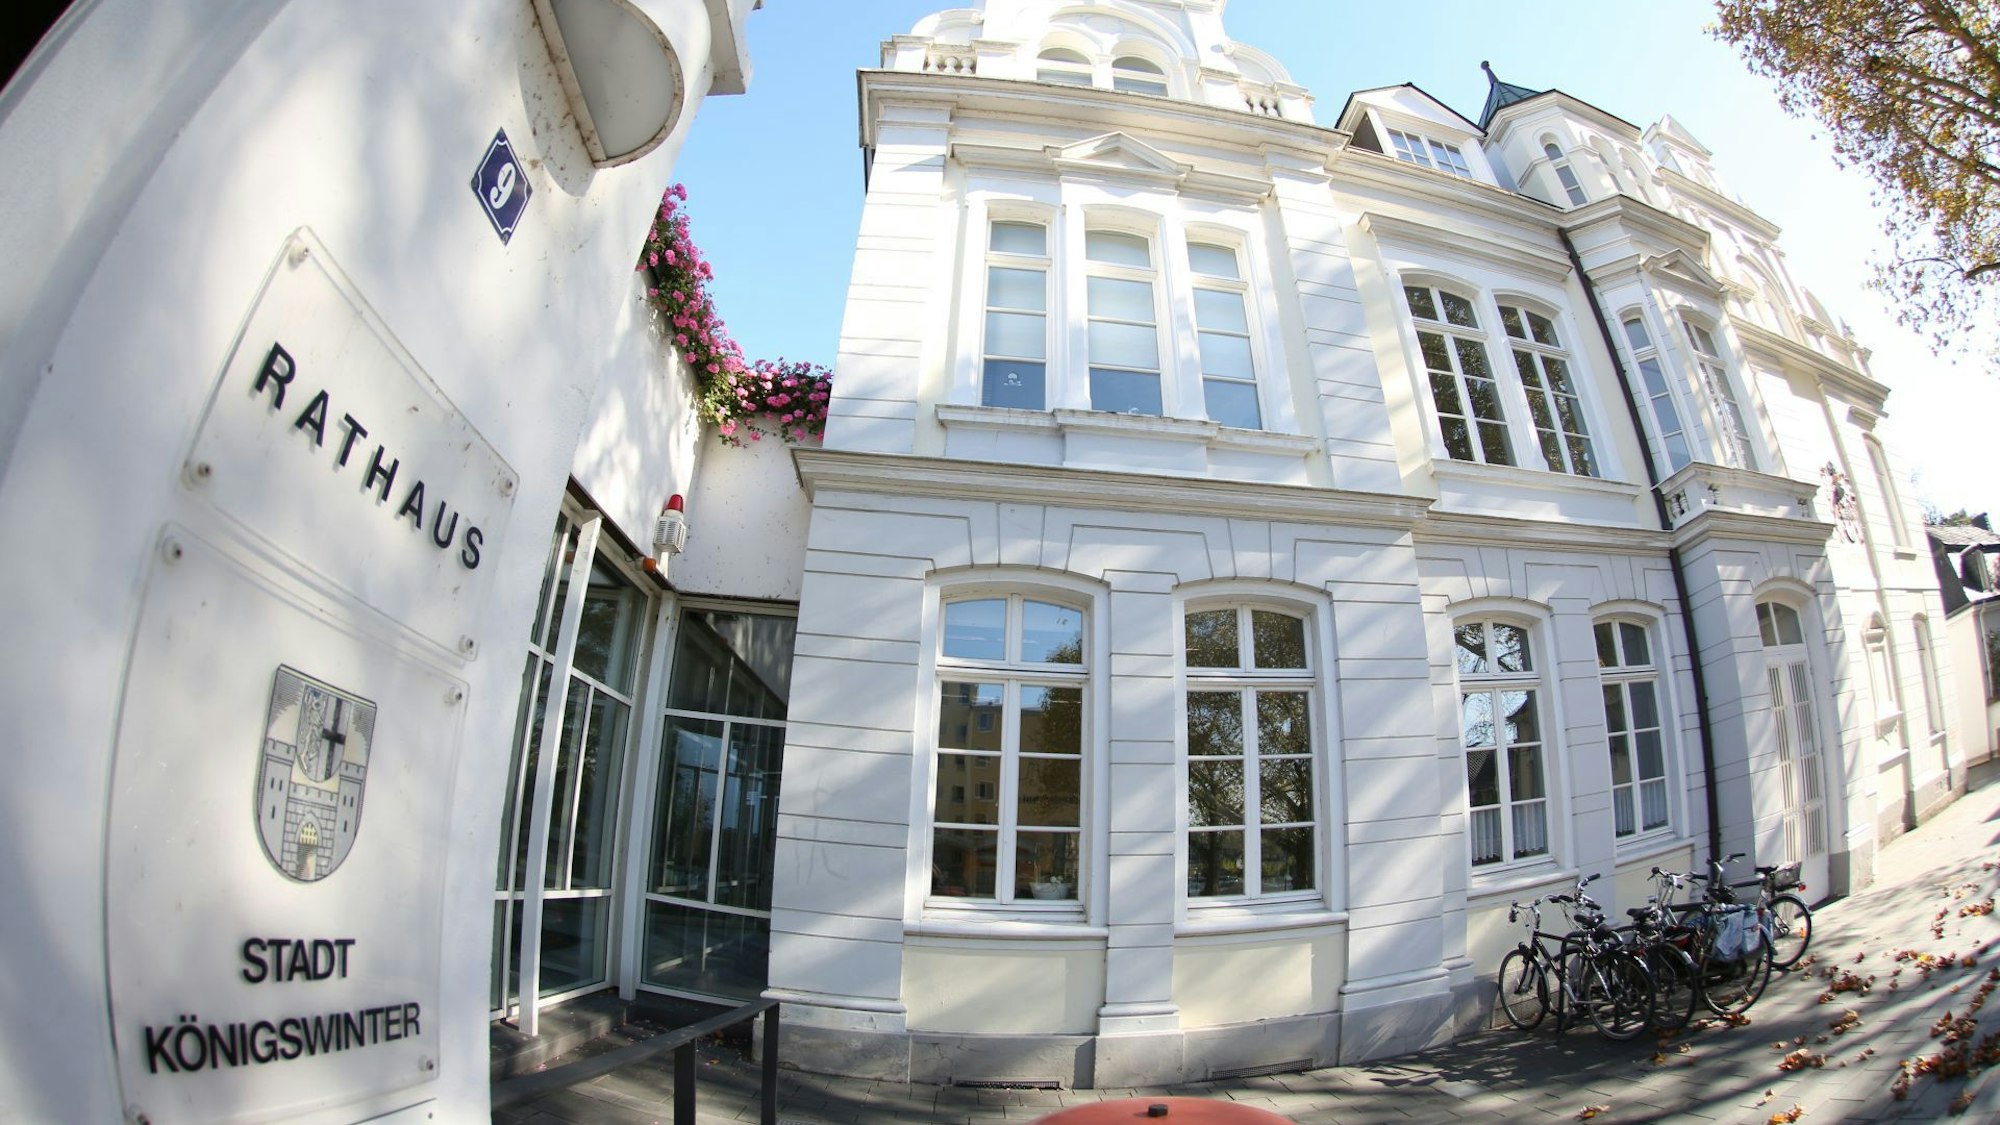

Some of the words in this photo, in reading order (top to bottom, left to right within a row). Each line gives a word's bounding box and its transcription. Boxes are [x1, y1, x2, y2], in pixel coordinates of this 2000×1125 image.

[489, 162, 516, 209] 9
[254, 341, 484, 570] RATHAUS
[241, 938, 355, 983] STADT
[144, 1002, 421, 1074] KÖNIGSWINTER
